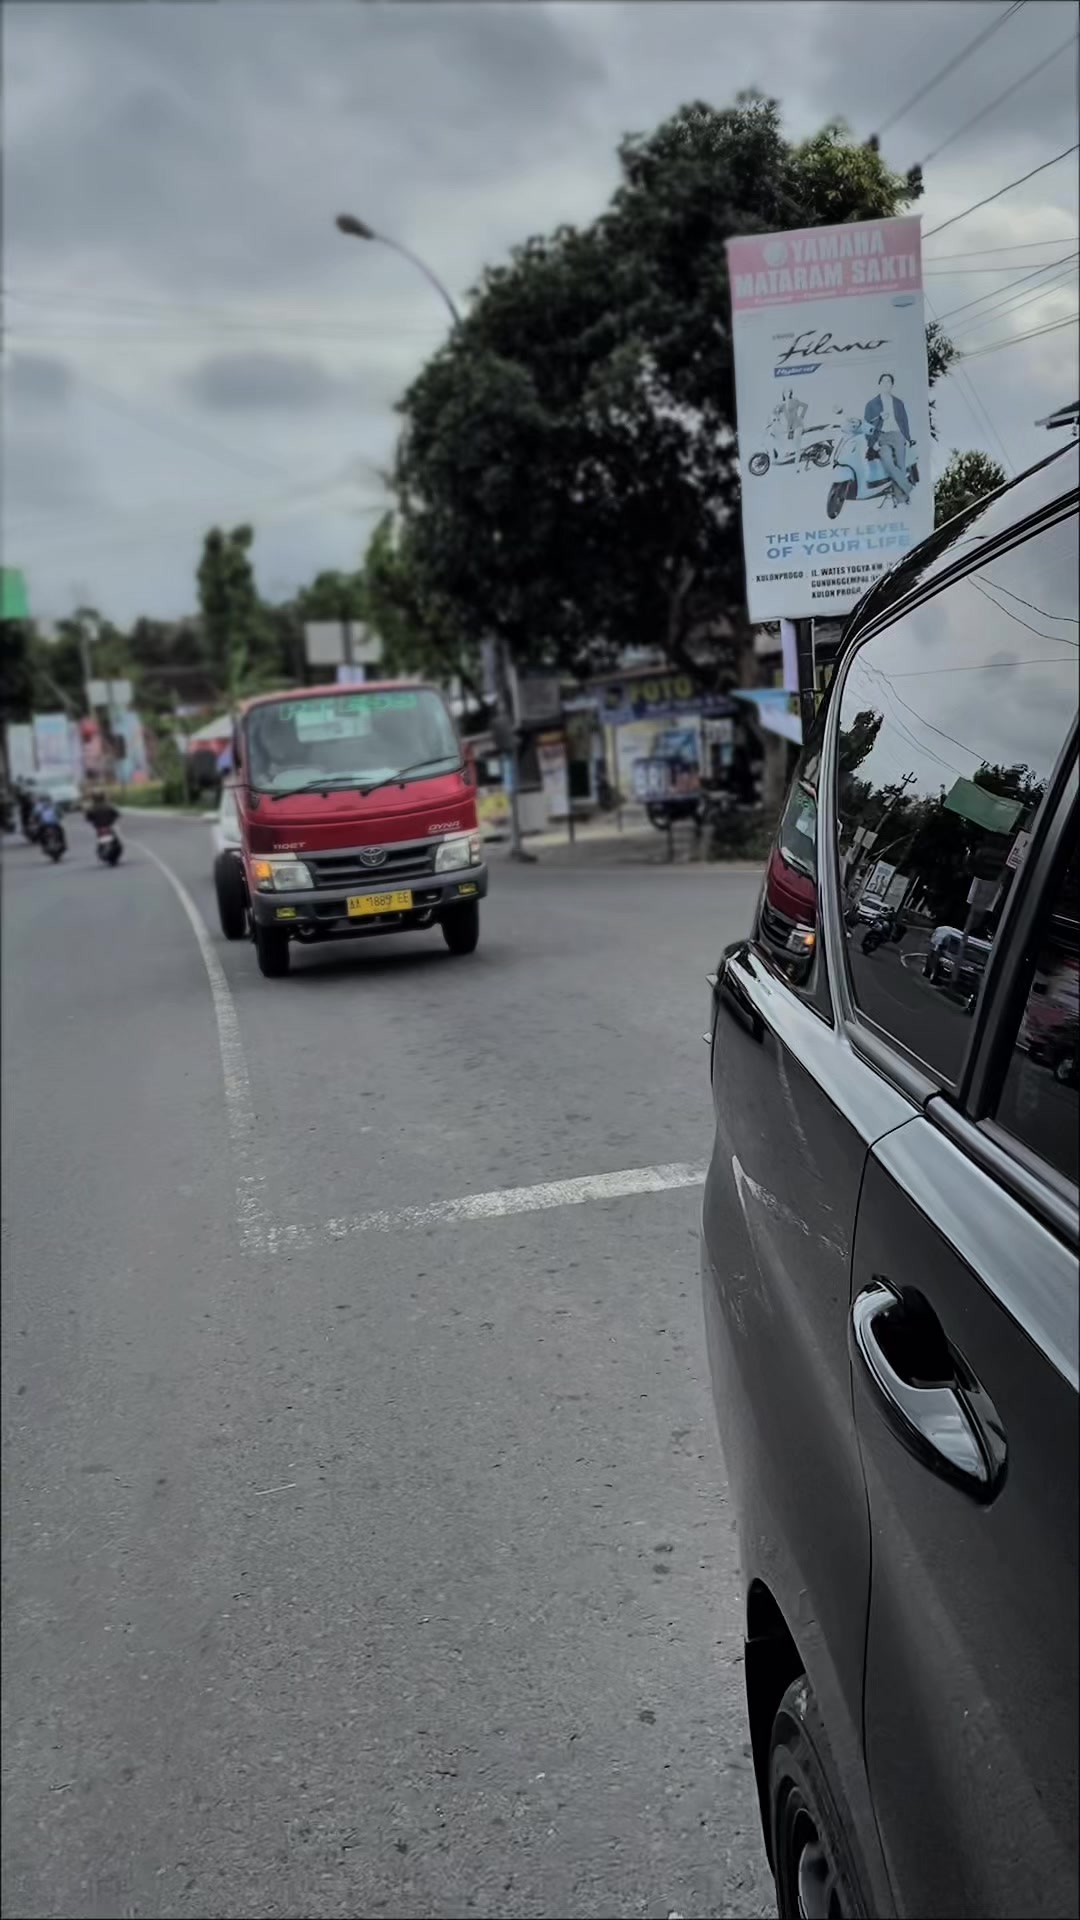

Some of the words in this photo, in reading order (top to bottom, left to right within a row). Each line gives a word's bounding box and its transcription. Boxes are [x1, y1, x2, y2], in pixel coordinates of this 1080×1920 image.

[792, 229, 885, 262] YAMAHA
[735, 261, 843, 298] MATARAM
[852, 254, 916, 284] SAKTI
[766, 532, 800, 545] THE
[805, 527, 850, 541] NEXT
[855, 522, 909, 536] LEVEL
[766, 547, 793, 560] OF
[803, 540, 859, 557] YOUR
[866, 534, 911, 550] LIFE
[821, 566, 845, 576] WATES
[846, 564, 870, 574] YOGYA
[812, 590, 835, 599] KULON
[631, 679, 693, 704] FOTO
[429, 821, 460, 831] DYNA
